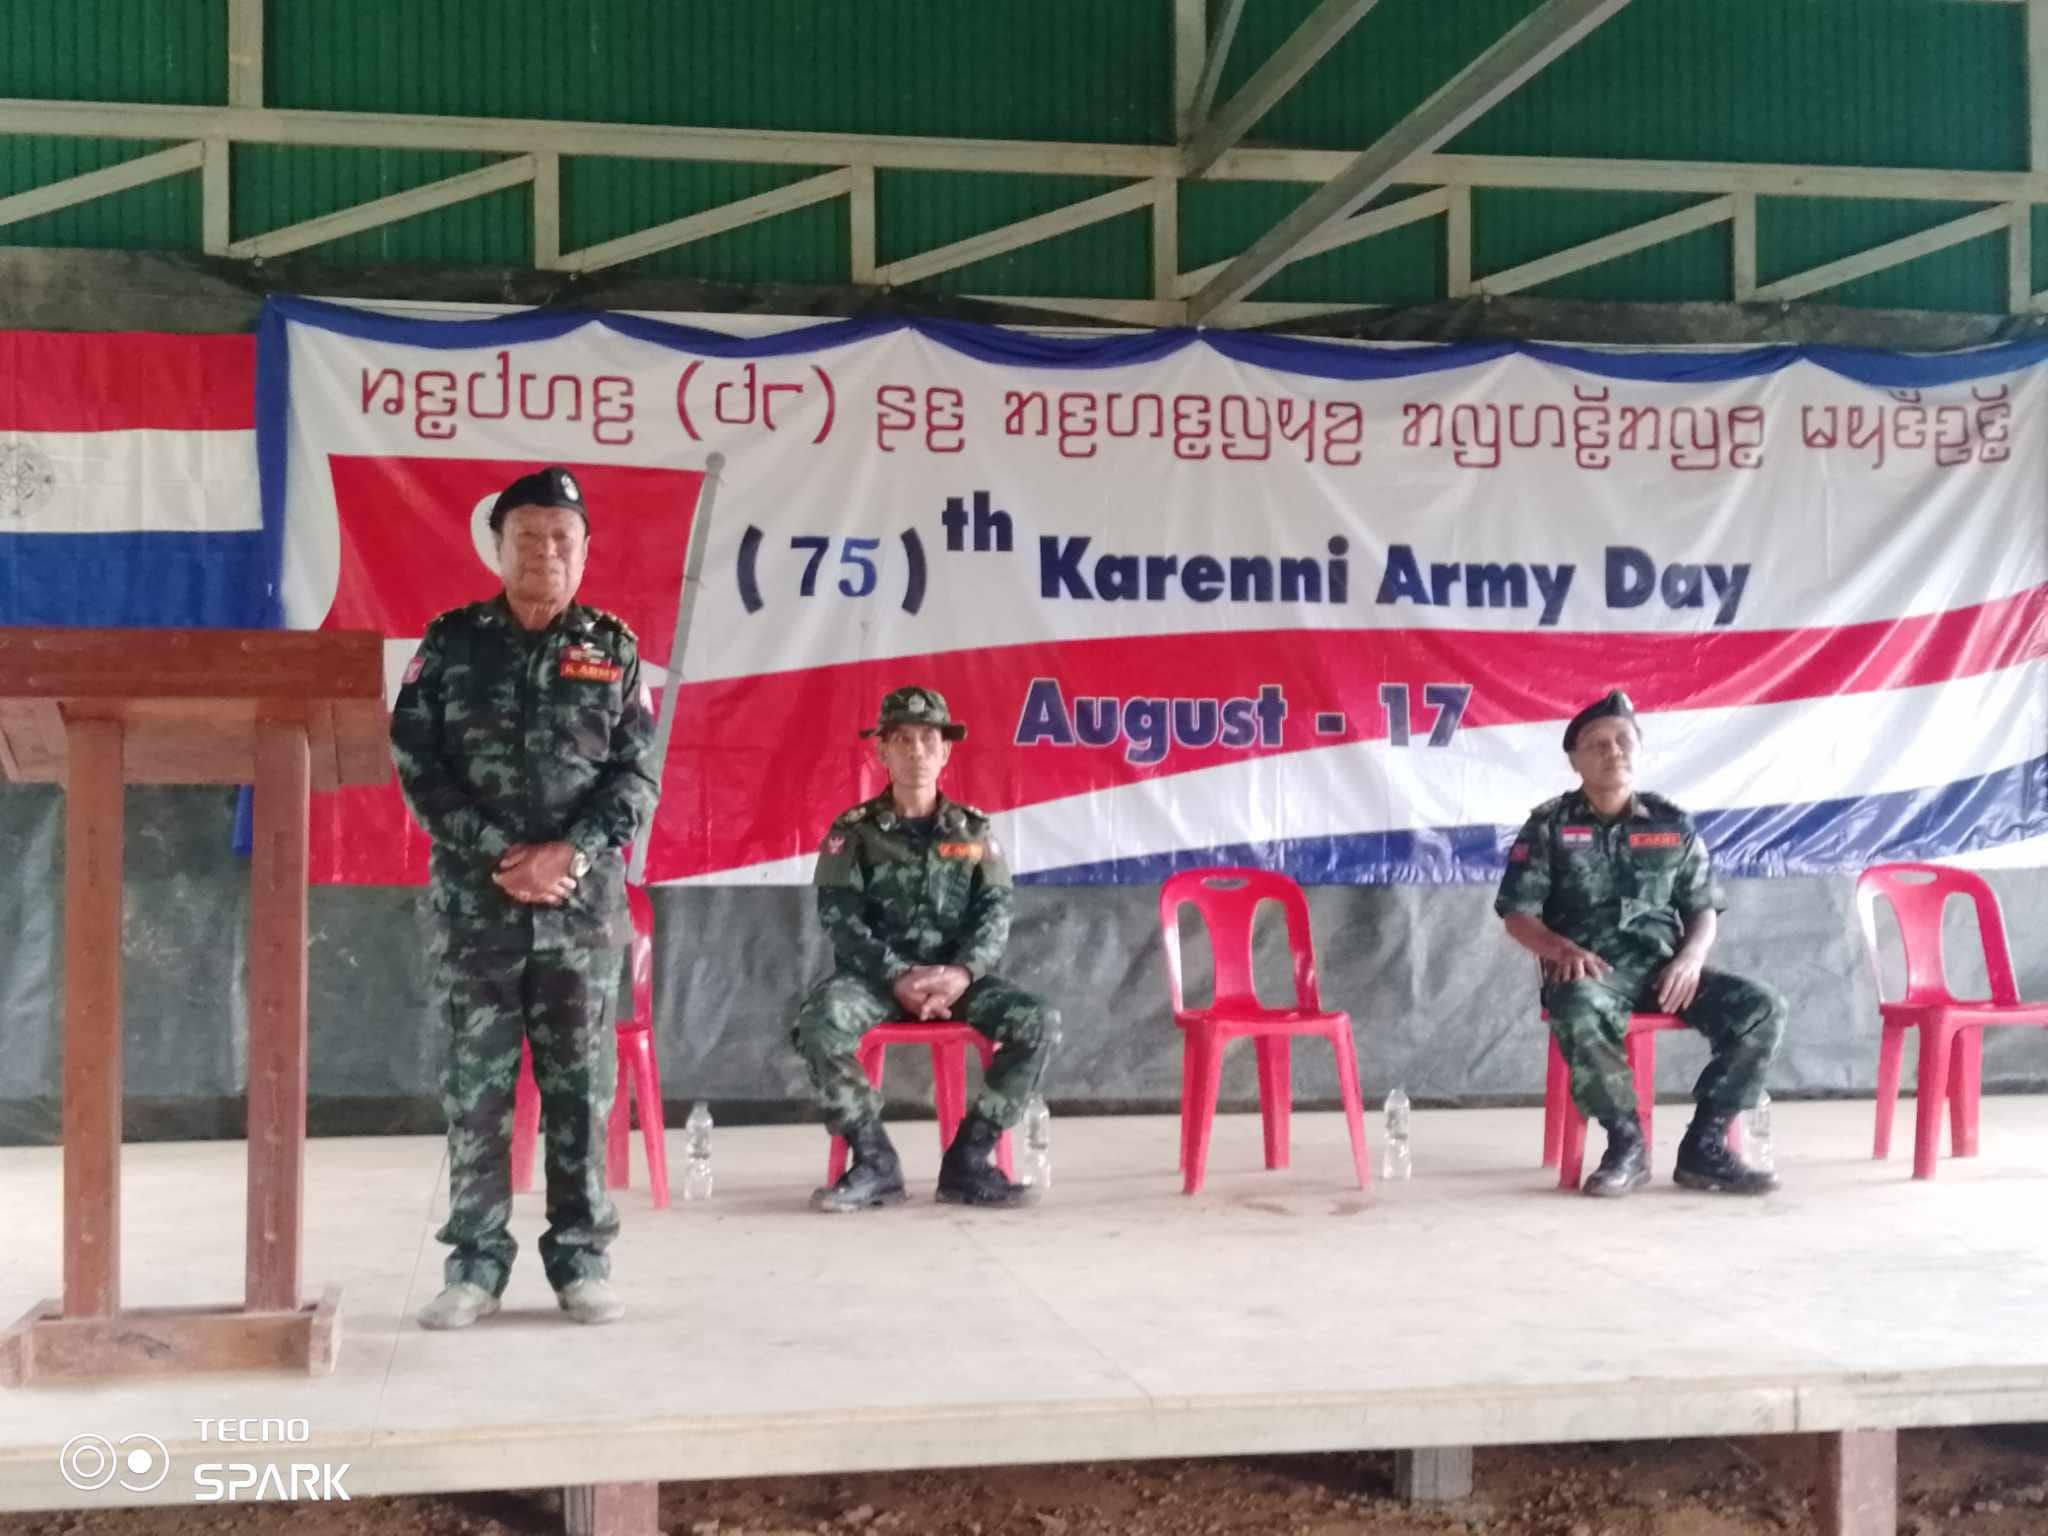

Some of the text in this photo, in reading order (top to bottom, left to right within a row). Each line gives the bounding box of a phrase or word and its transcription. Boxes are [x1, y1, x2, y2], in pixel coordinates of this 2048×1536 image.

[1040, 535, 1349, 604] Karenni
[1376, 545, 1576, 627] Army
[1605, 546, 1750, 626] Day
[1015, 677, 1287, 763] August
[1378, 683, 1474, 749] 17
